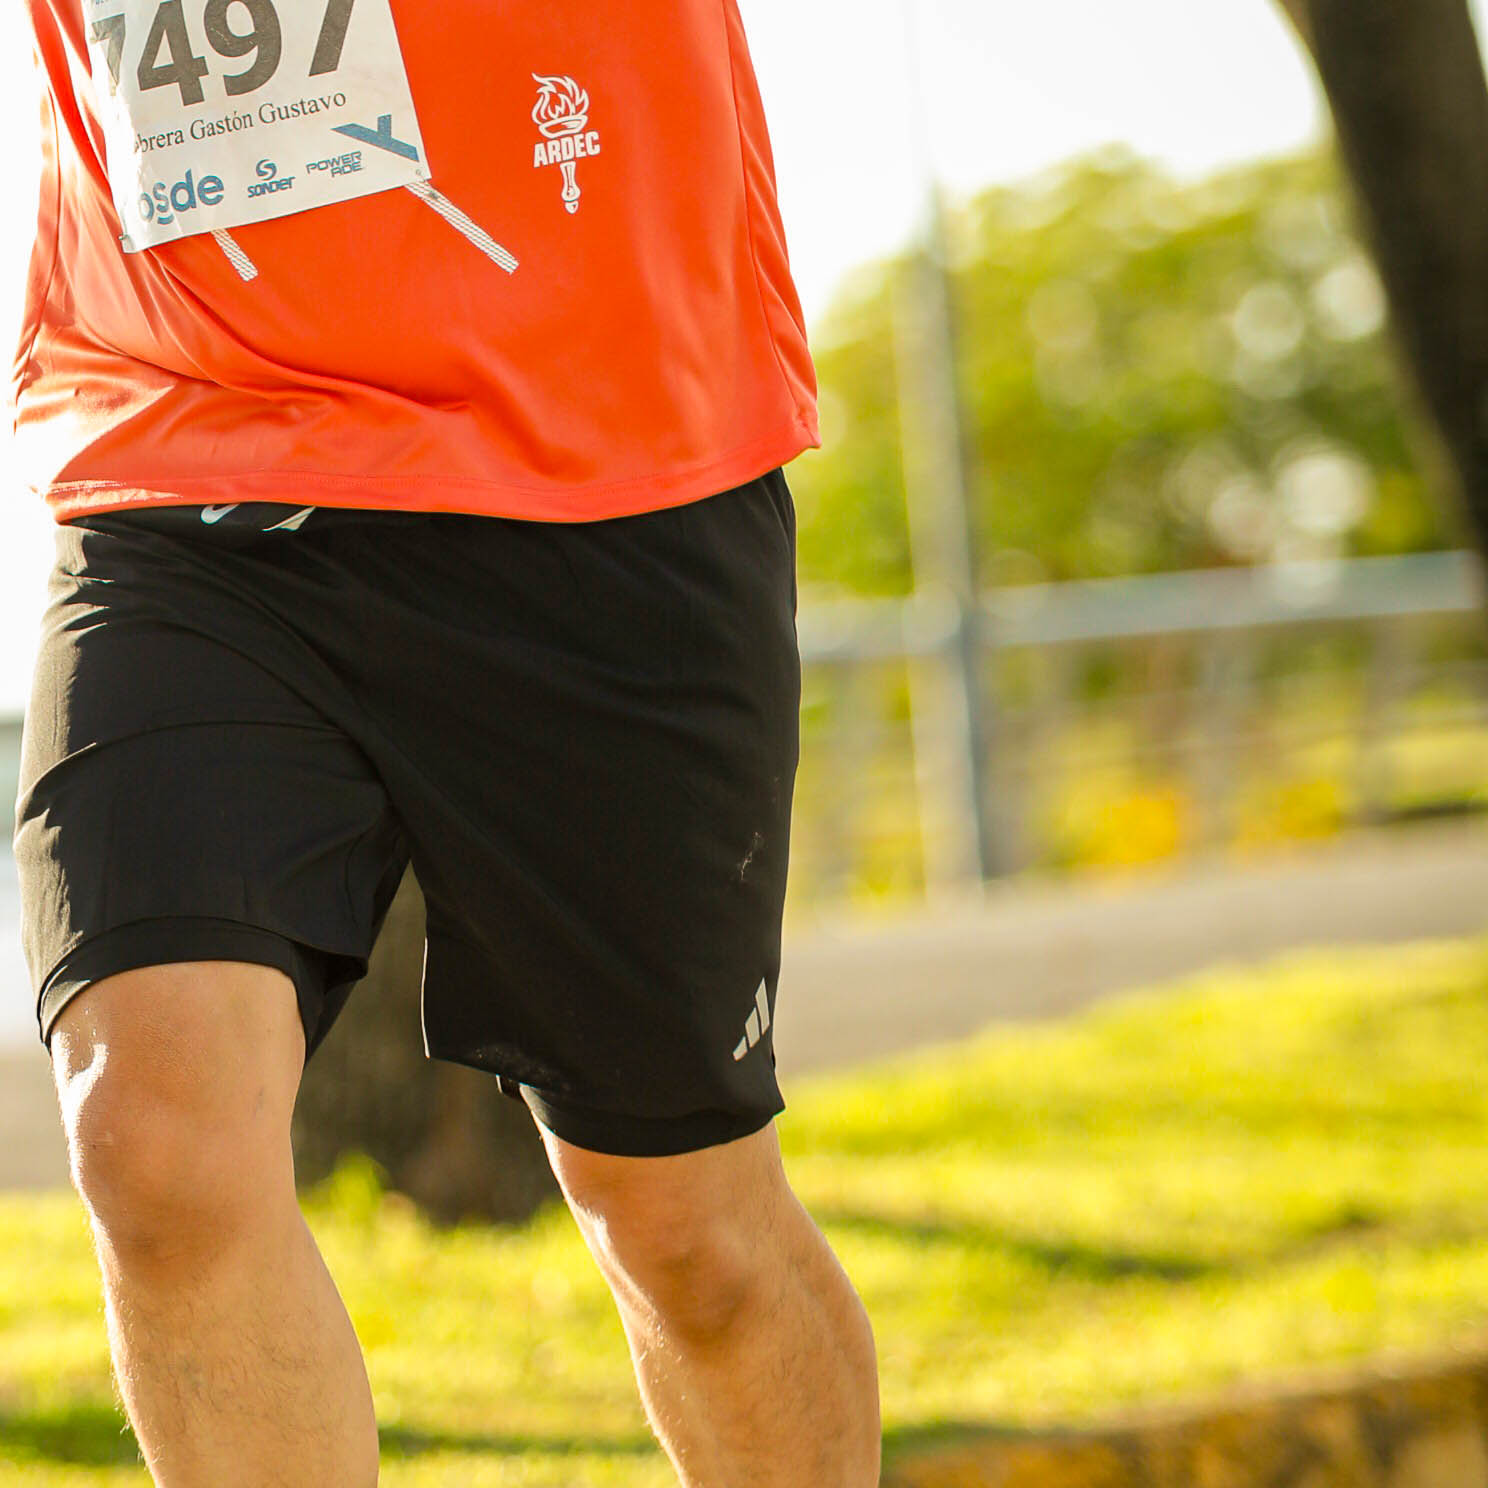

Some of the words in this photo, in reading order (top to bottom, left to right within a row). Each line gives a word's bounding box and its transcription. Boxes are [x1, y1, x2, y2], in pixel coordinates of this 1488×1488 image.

[190, 111, 254, 141] Gastón
[258, 92, 347, 124] Gustavo
[306, 150, 362, 174] POWER
[533, 130, 601, 168] ARDEC
